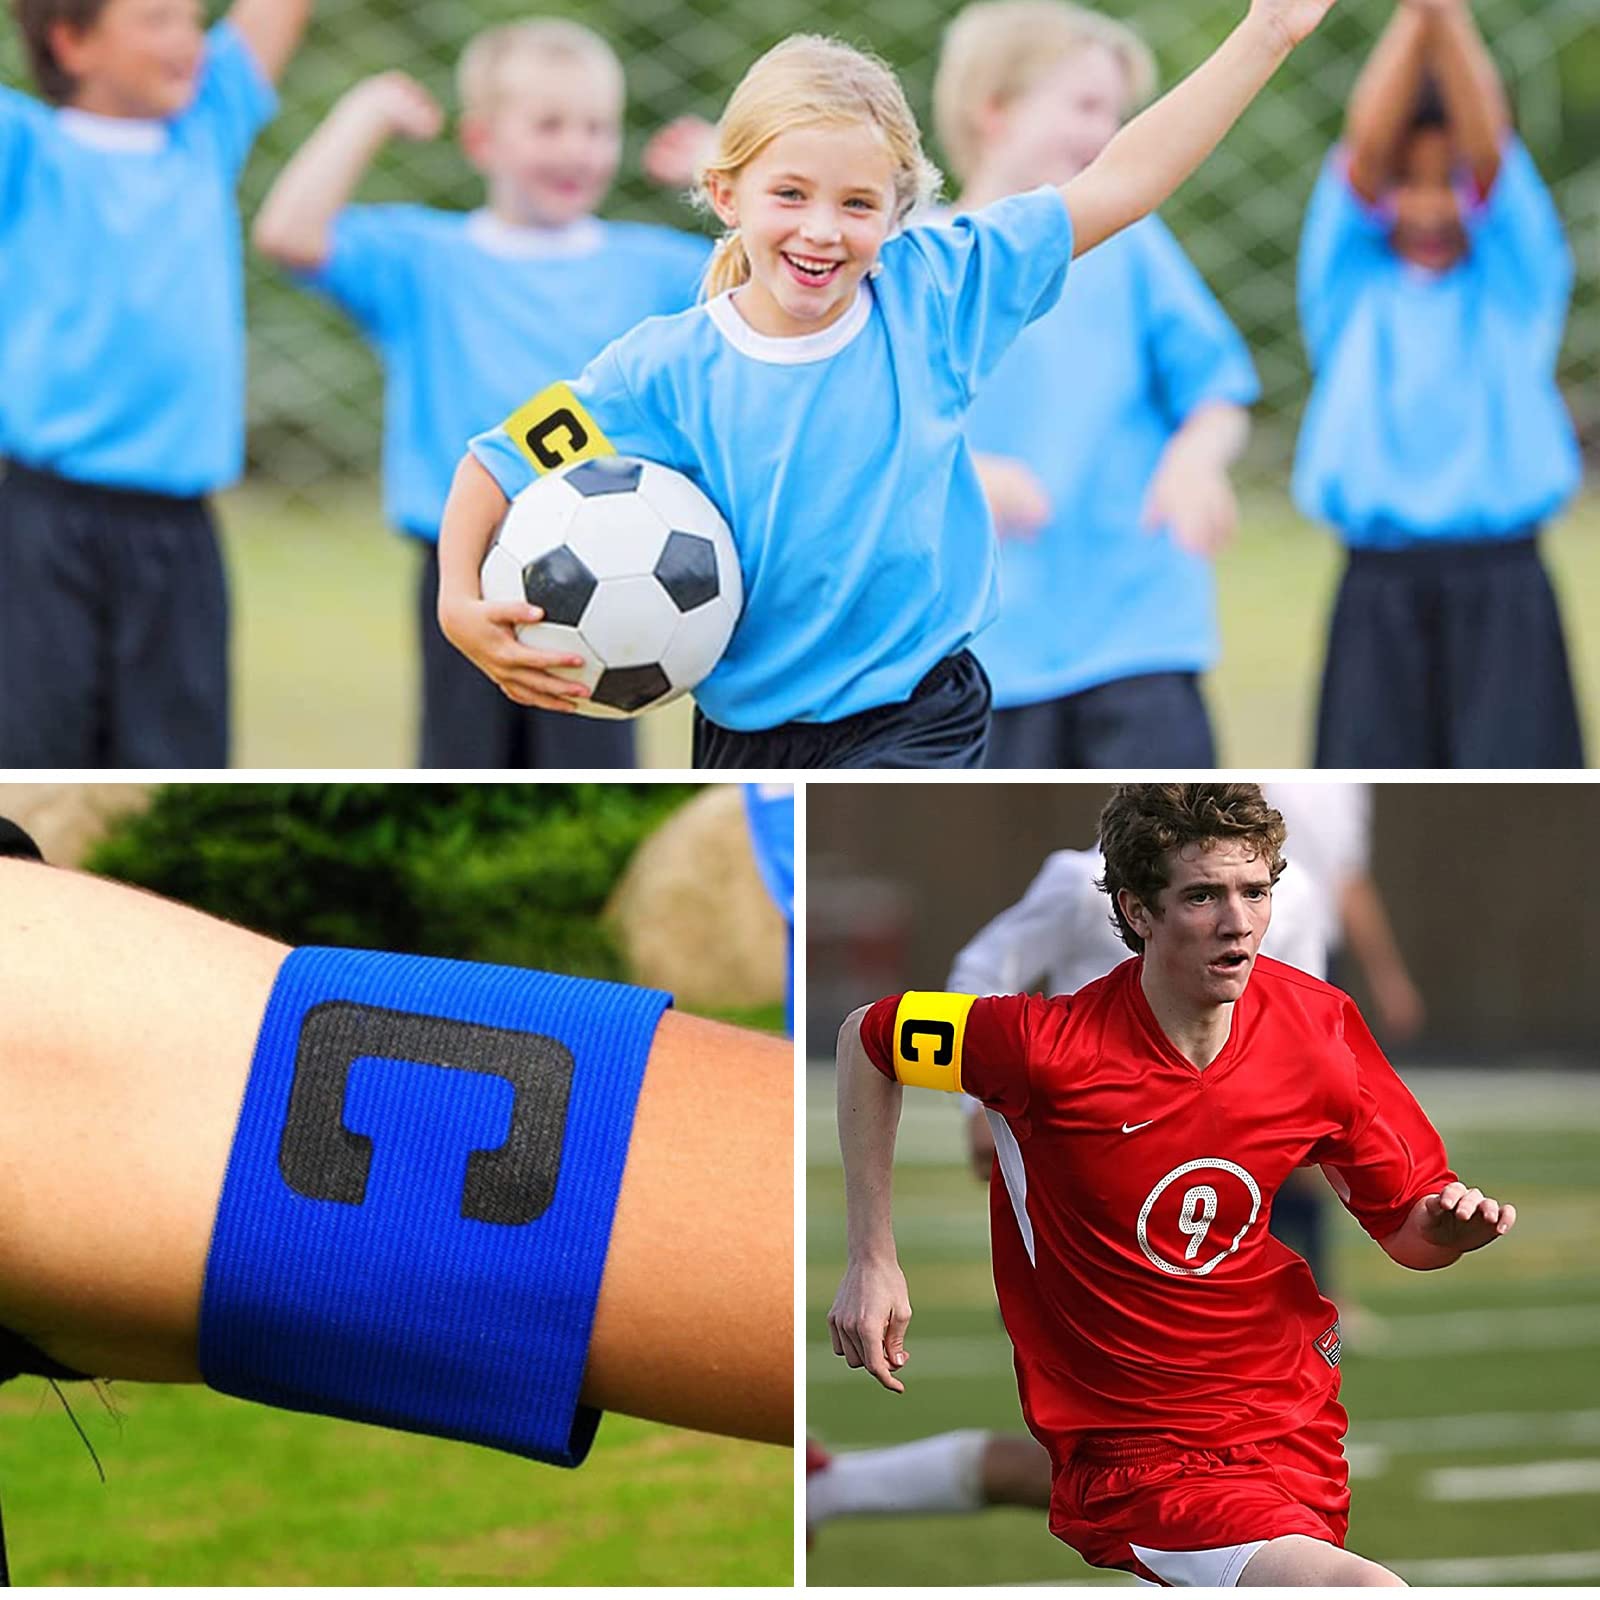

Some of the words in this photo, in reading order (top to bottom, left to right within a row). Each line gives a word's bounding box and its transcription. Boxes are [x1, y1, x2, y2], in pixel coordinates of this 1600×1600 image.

[526, 408, 588, 469] C
[900, 1019, 955, 1066] C
[278, 998, 576, 1227] C
[1178, 1185, 1218, 1260] 9
